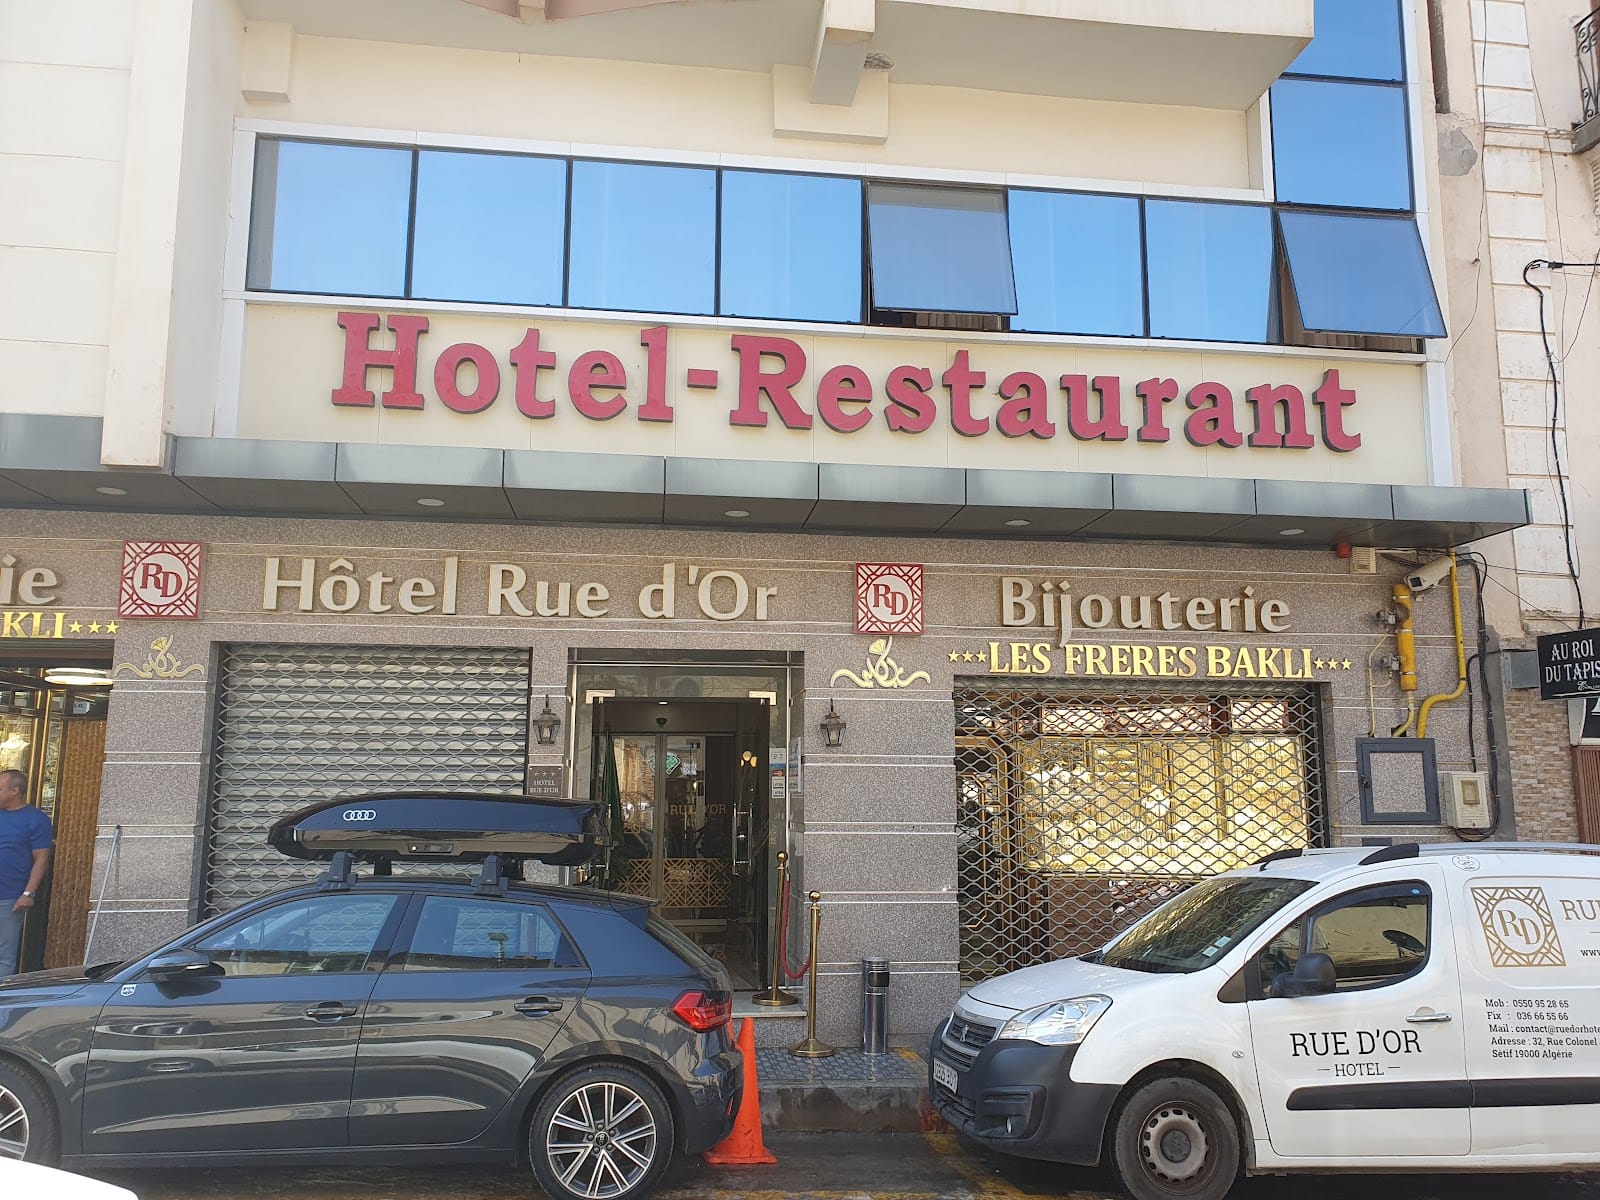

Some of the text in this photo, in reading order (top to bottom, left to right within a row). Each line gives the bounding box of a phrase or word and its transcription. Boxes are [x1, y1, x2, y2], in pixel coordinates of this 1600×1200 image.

[331, 311, 1361, 453] Hotel-Restaurant
[140, 562, 183, 598] RD
[262, 556, 778, 621] Hôtel Rue d'Or
[872, 583, 909, 616] RD
[1001, 576, 1292, 648] Bijouterie
[988, 642, 1313, 679] LES FRERES BAKLI
[1551, 639, 1595, 661] AU ROI
[1545, 661, 1600, 683] DU TAPIS
[1496, 909, 1541, 945] RD
[1512, 999, 1533, 1008] 0550
[1534, 999, 1546, 1008] 95
[1546, 999, 1557, 1008] 28
[1558, 999, 1570, 1008] 65
[1516, 1011, 1533, 1020] 036
[1534, 1012, 1545, 1020] 66
[1546, 1012, 1557, 1021] 55
[1558, 1012, 1569, 1021] 66
[1289, 1029, 1422, 1057] RUE D'OR
[1515, 1049, 1540, 1058] 19000
[1547, 1037, 1564, 1046] Rue
[1565, 1037, 1598, 1046] Colonel
[1334, 1062, 1385, 1077] HOTEL
